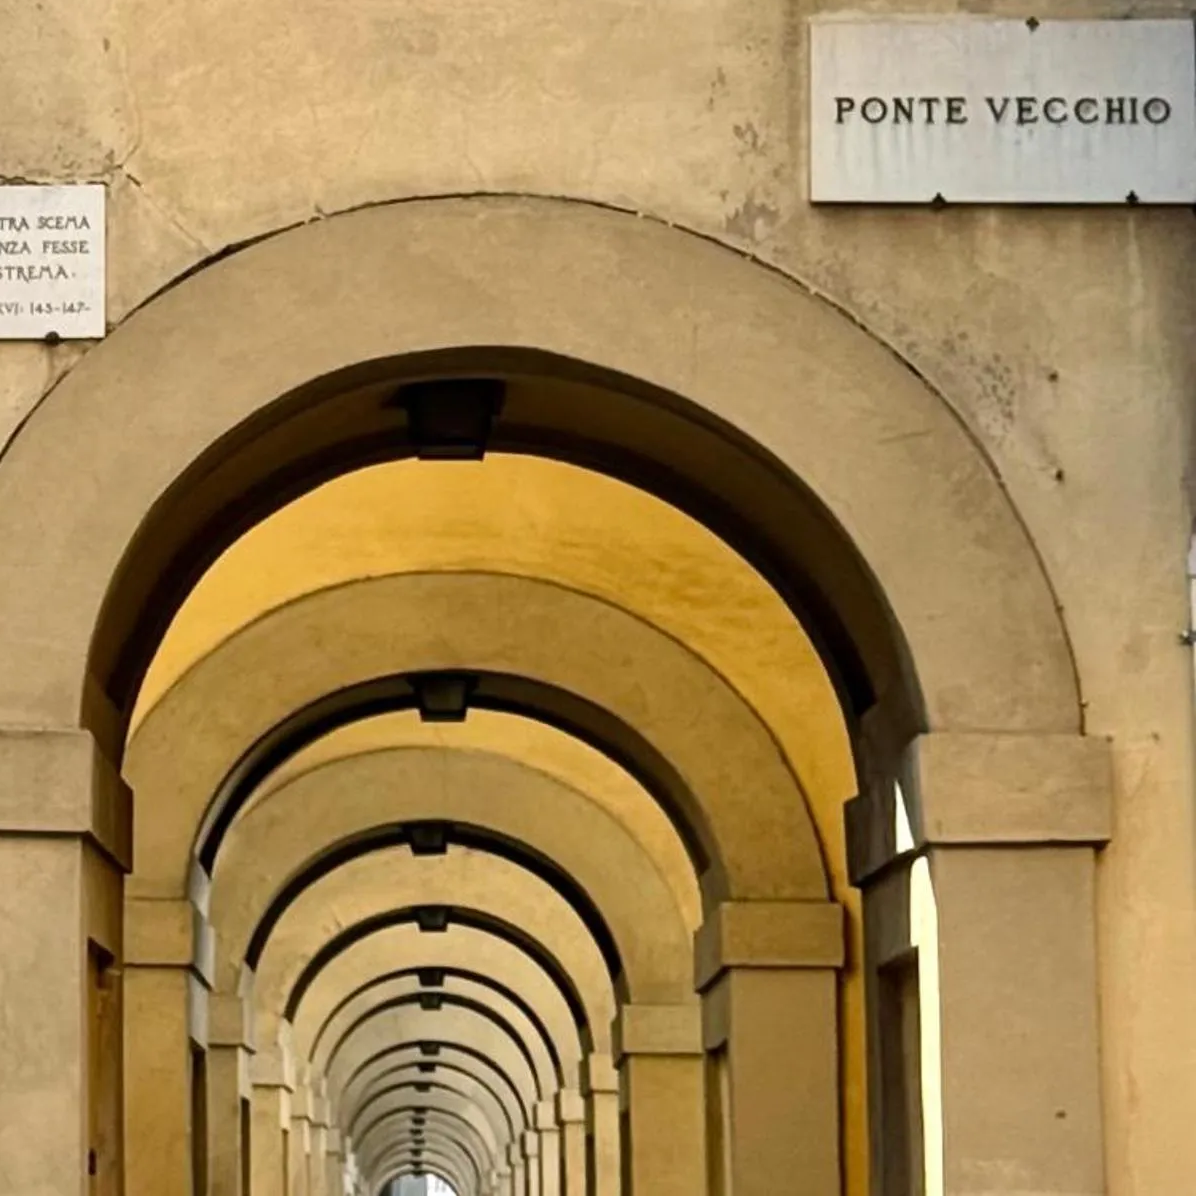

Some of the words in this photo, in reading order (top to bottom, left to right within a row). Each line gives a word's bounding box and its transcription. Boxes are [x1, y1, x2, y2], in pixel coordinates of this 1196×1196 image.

[834, 96, 968, 125] PONTE
[984, 96, 1172, 126] VECCHIO
[37, 216, 91, 230] SCEMA
[42, 240, 90, 255] FESSE
